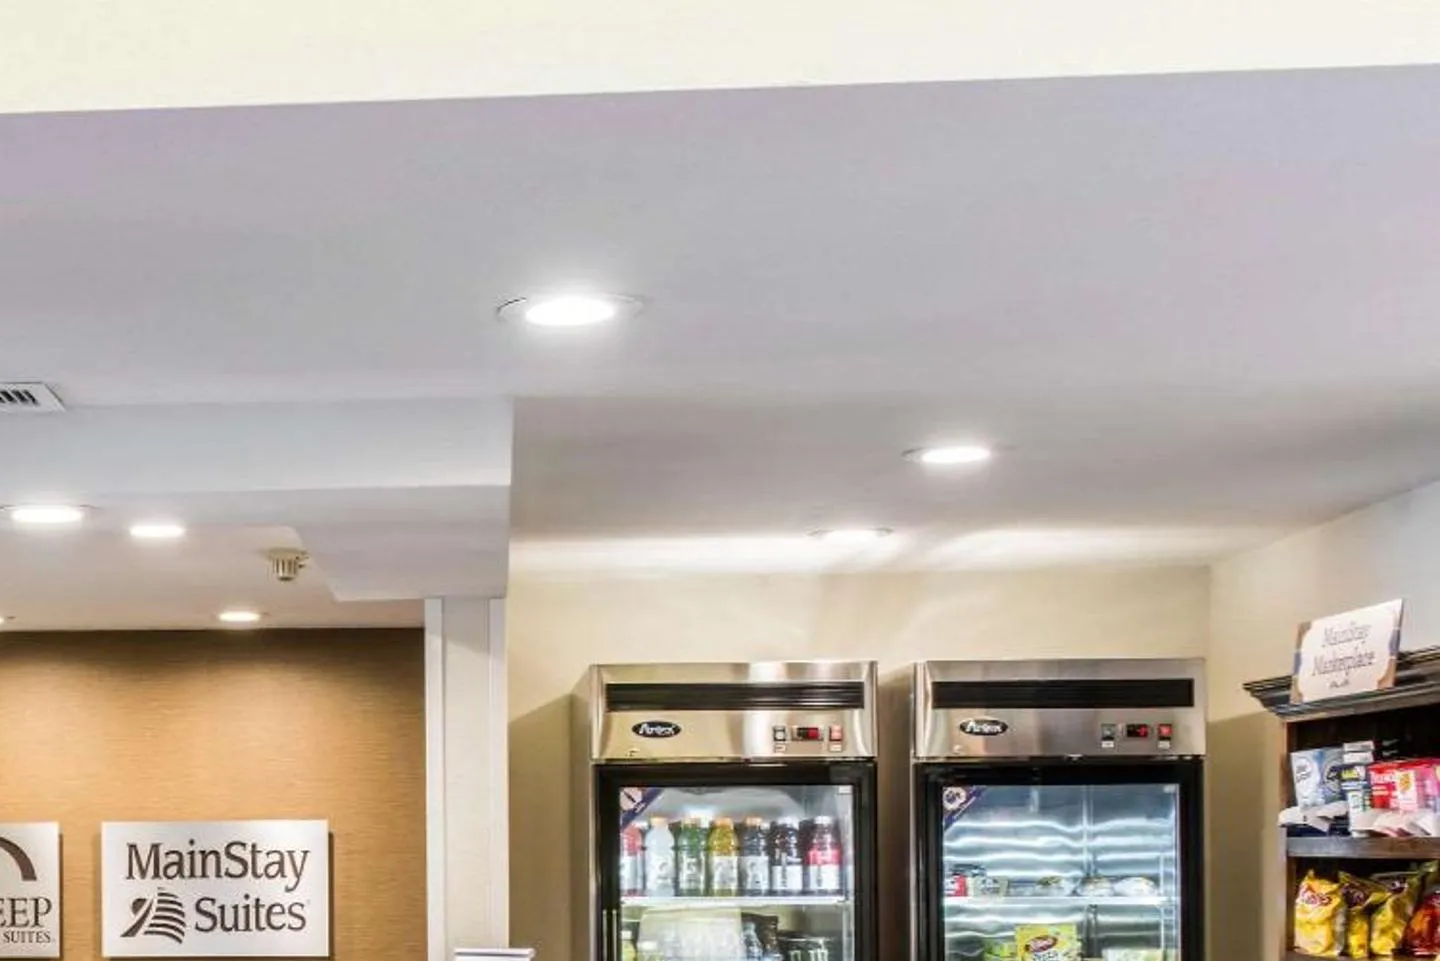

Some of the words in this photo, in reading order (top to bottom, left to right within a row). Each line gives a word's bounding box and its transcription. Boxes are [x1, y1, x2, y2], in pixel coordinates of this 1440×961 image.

[125, 838, 311, 892] MainStay
[194, 893, 307, 932] Suites
[3, 931, 52, 943] SUITES
